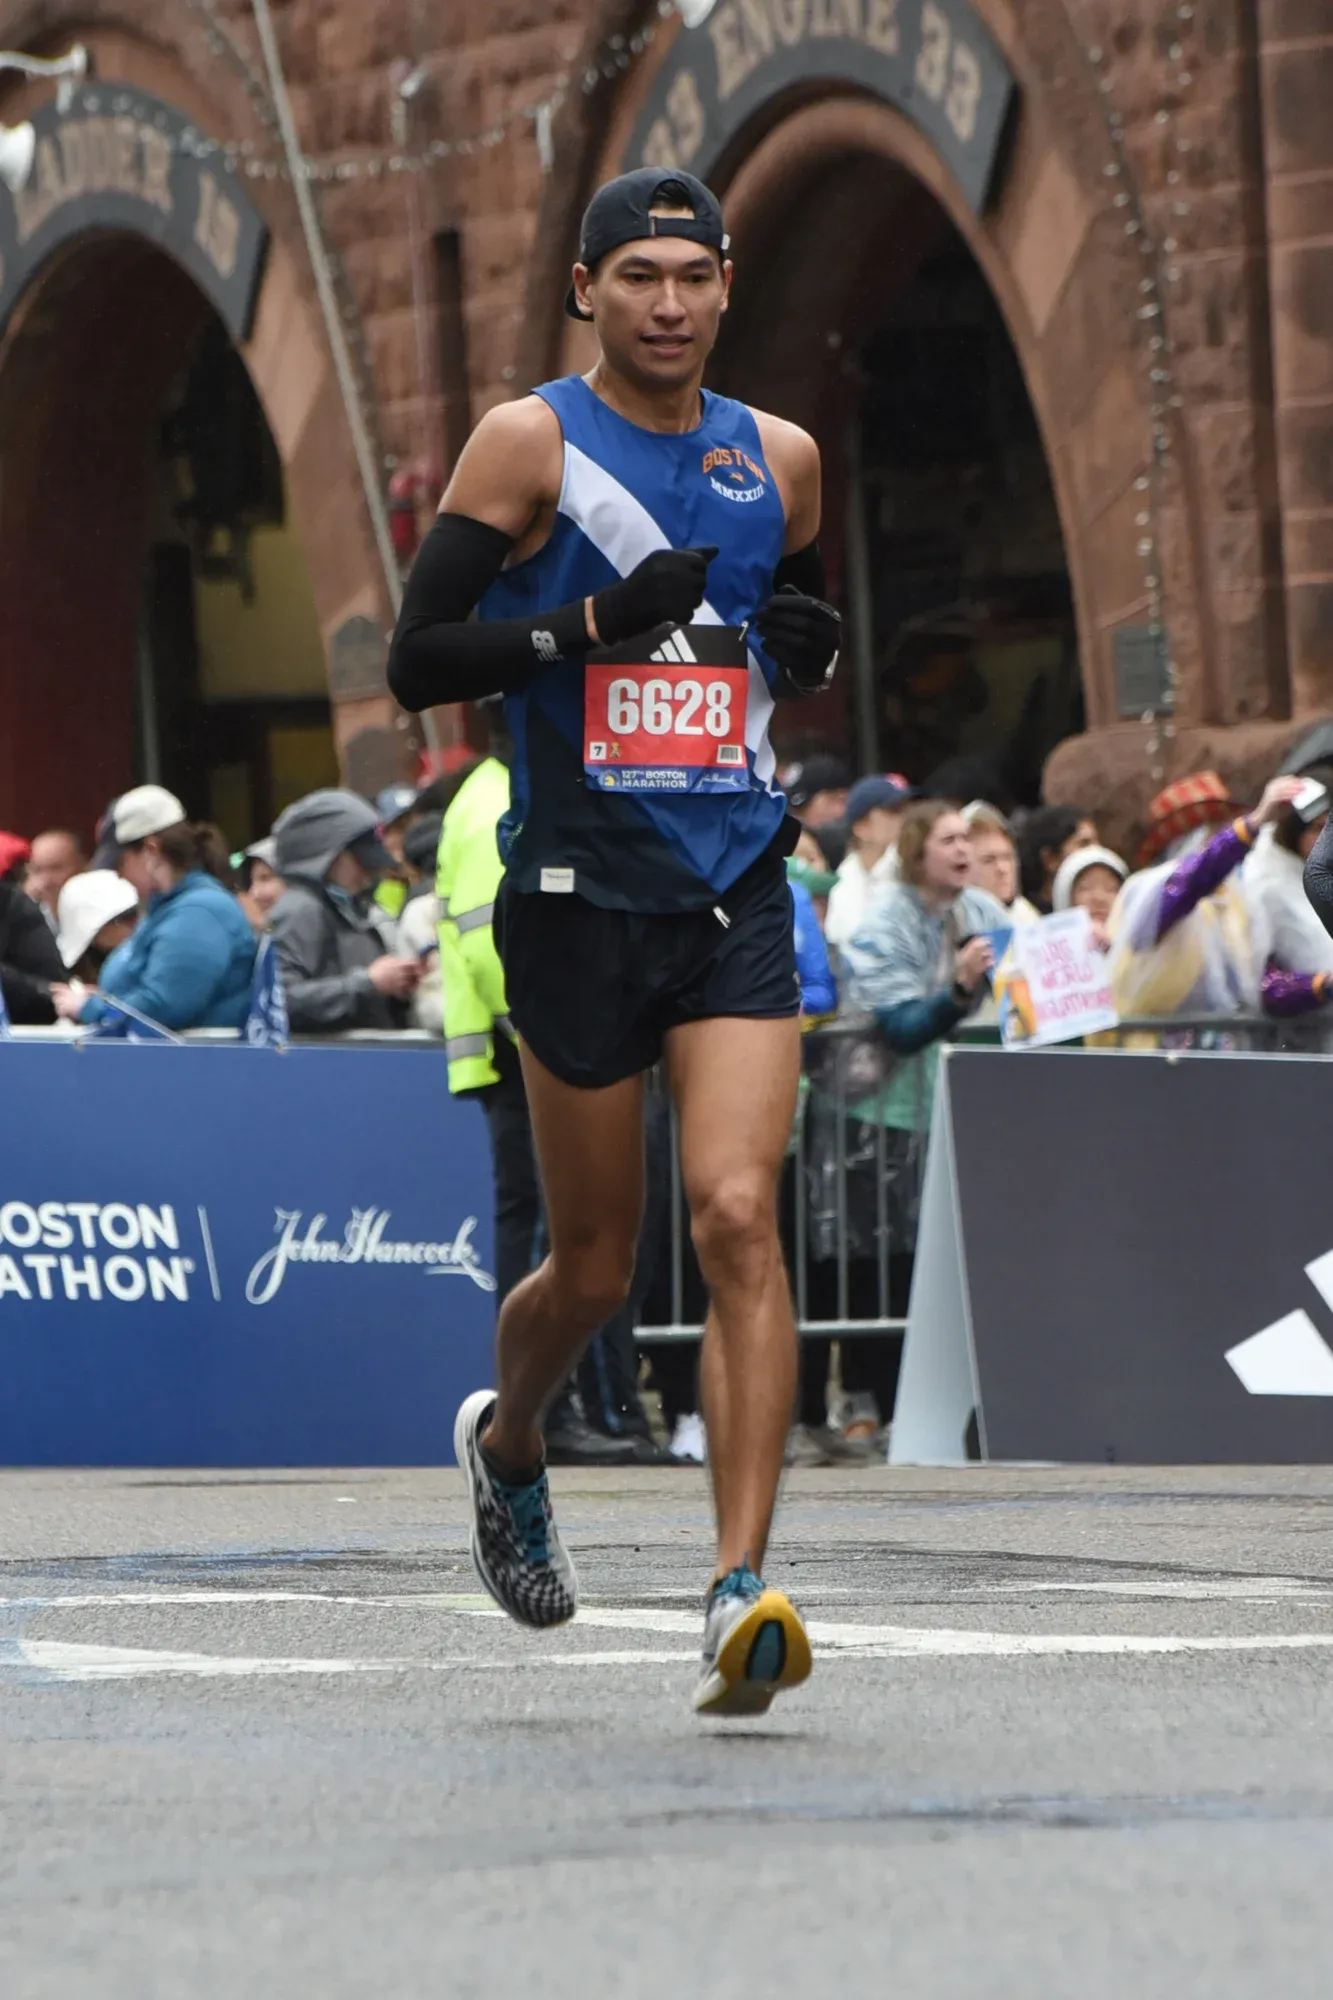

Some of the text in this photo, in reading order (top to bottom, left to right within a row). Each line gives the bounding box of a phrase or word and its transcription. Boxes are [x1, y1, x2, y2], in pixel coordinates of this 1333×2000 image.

[607, 678, 732, 737] 6628
[594, 746, 603, 757] 7
[622, 779, 688, 789] MARATHON
[645, 770, 687, 779] BOSTON
[0, 1200, 180, 1250] OSTON
[243, 1205, 498, 1306] John Hancock
